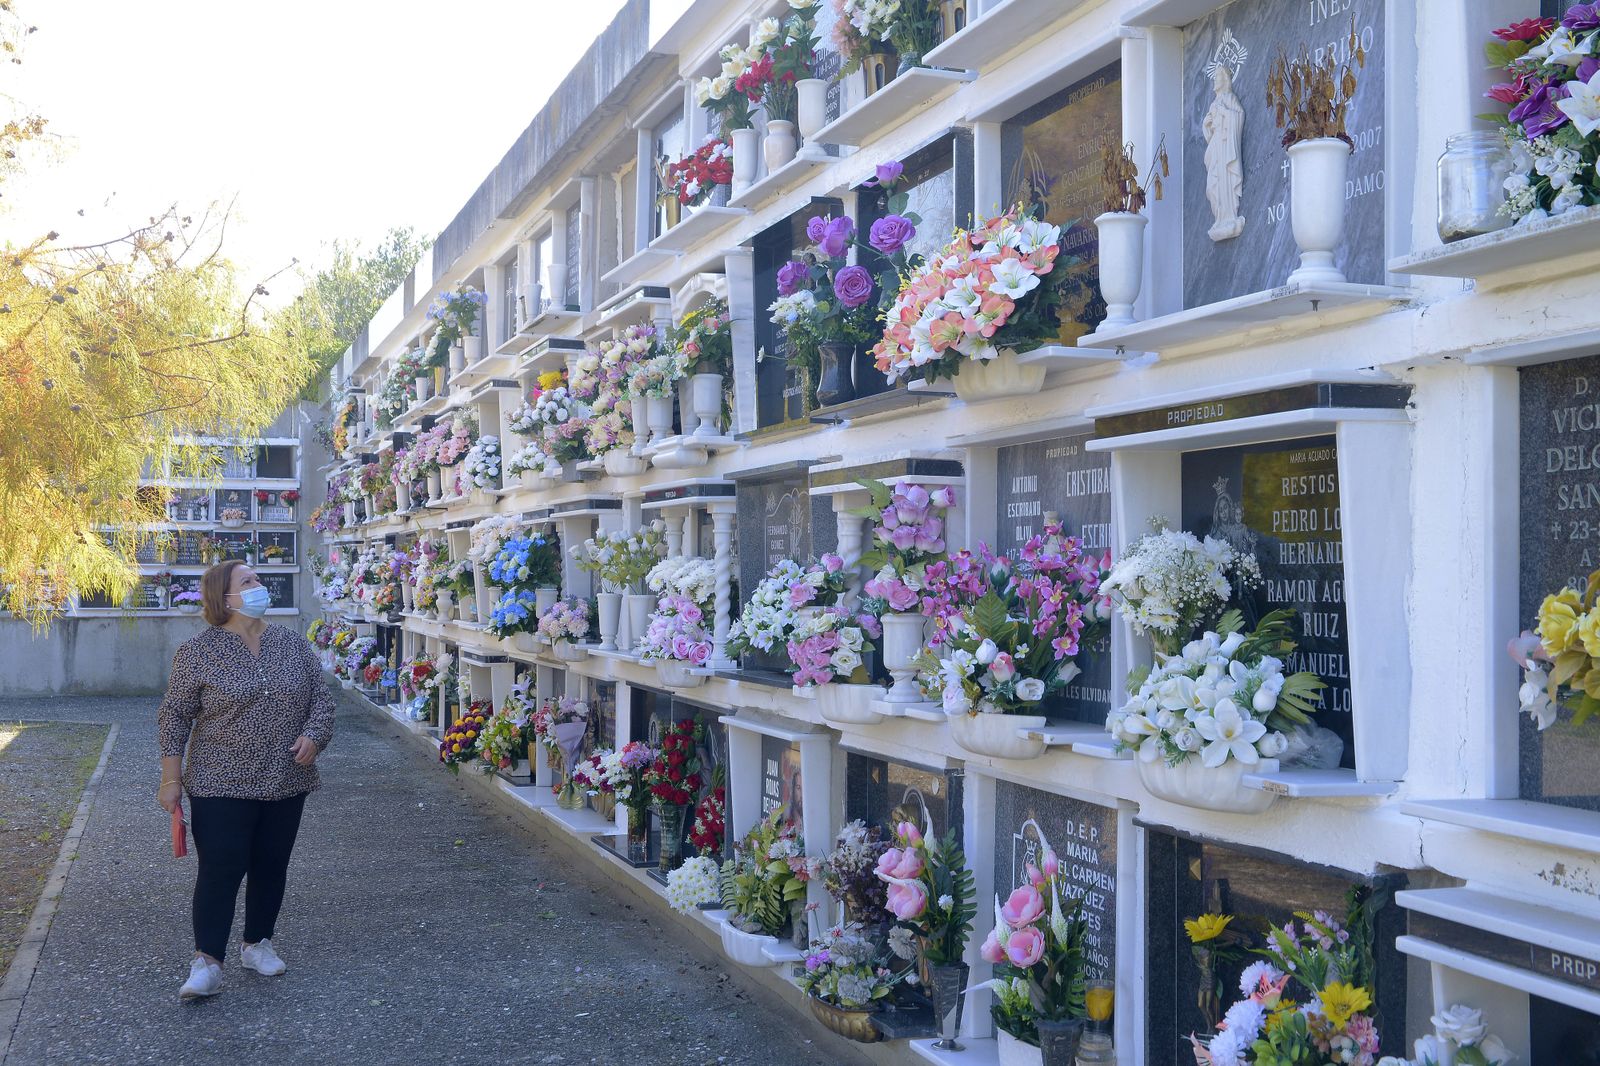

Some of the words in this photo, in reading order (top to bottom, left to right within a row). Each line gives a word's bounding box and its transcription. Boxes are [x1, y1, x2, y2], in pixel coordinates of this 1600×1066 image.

[1267, 203, 1285, 225] NO
[1167, 404, 1224, 424] PROPIEDAD
[1045, 445, 1078, 459] PROPIEDAD
[1012, 475, 1038, 494] ANTONIO
[1281, 473, 1335, 497] RESTOS
[1007, 500, 1041, 519] ESCRIBANO
[1272, 508, 1318, 533] PEDRO
[1569, 520, 1600, 540] 23-
[1580, 548, 1592, 567] A
[1267, 579, 1317, 603] RAMON
[1303, 611, 1339, 638] RUIZ
[1286, 651, 1348, 679] MANUEL
[1066, 840, 1098, 865] MARIA
[1057, 859, 1069, 877] EL
[1072, 863, 1115, 893] CARMEN
[1086, 948, 1109, 969] AÑOS
[1551, 953, 1596, 980] PROP
